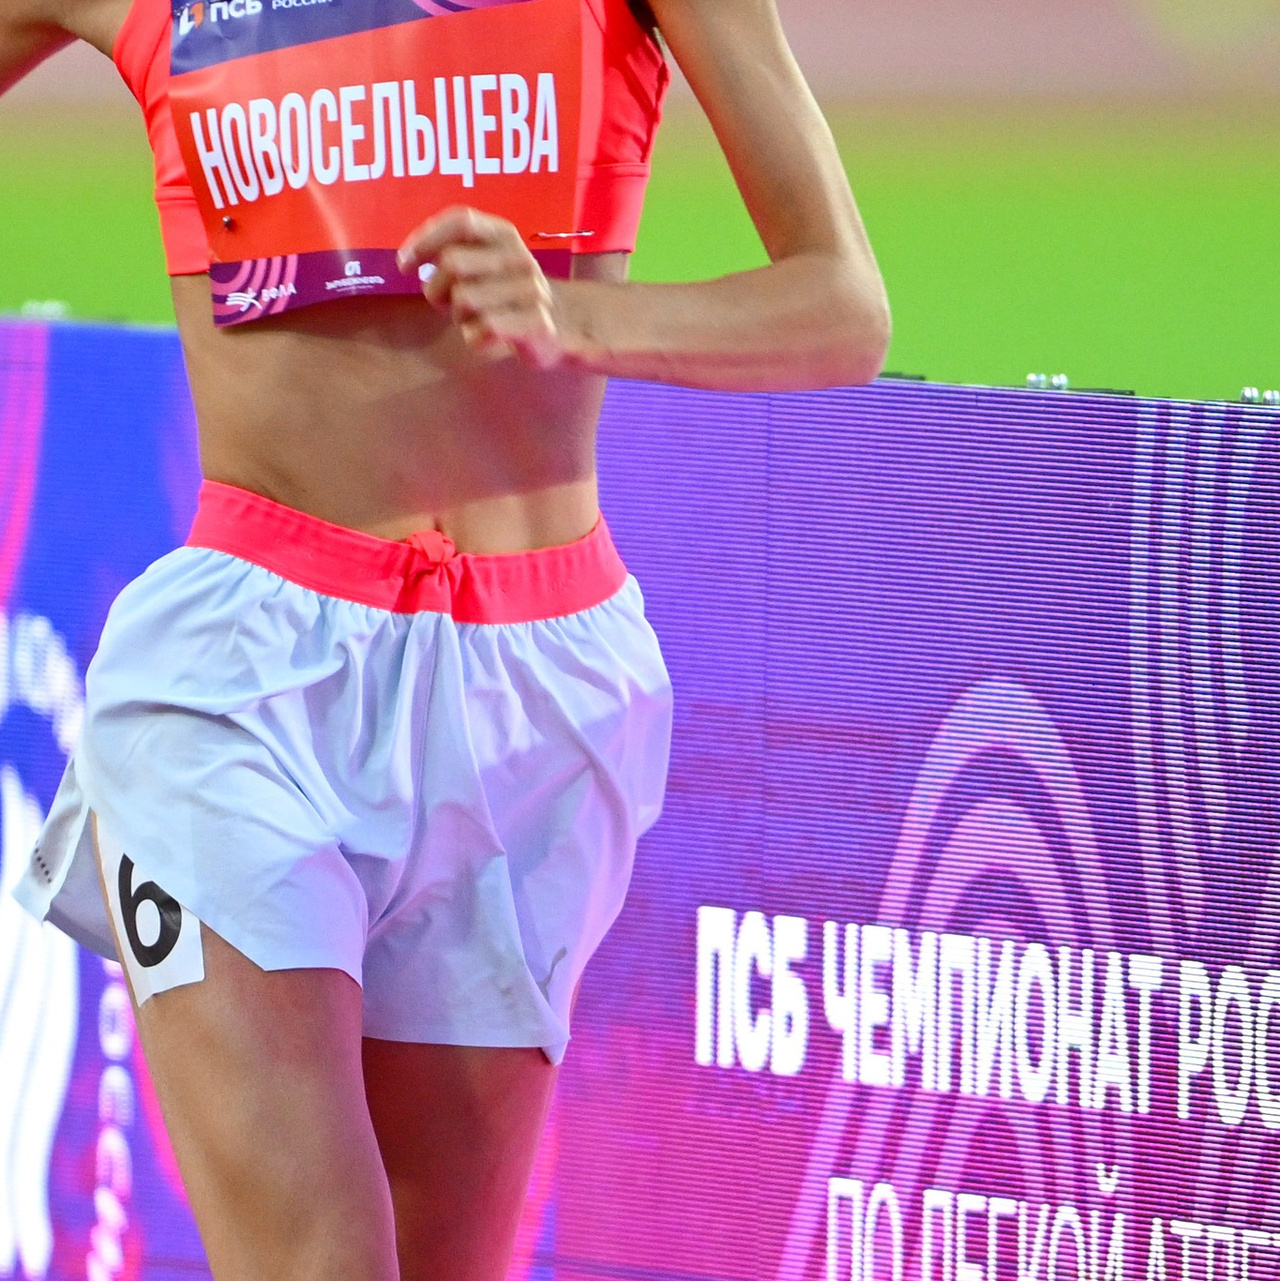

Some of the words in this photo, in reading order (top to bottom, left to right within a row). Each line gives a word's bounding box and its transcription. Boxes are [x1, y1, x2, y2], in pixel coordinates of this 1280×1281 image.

[189, 72, 560, 210] НОВОСЕЛЬЦЕВА
[117, 853, 183, 968] 6
[695, 905, 810, 1076] ПСБ
[822, 920, 1163, 1115] ЧЕМПИОНАТ
